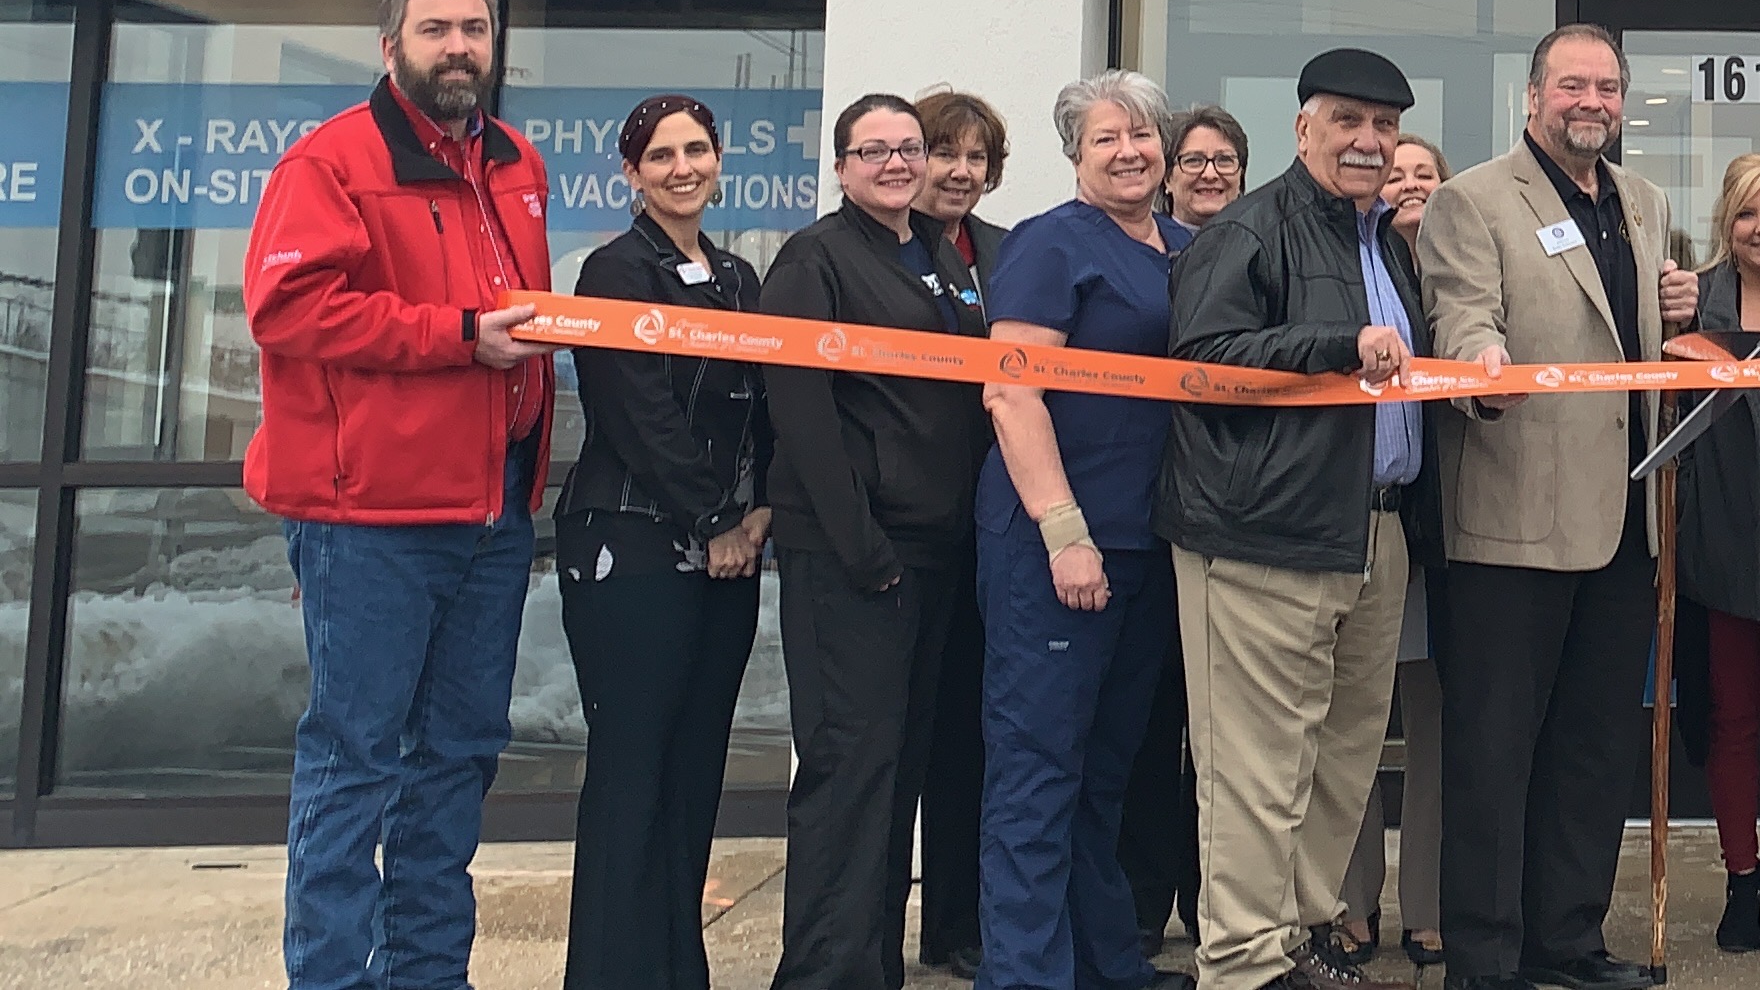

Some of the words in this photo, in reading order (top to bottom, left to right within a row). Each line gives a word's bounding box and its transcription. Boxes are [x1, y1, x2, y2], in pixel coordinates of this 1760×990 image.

[131, 118, 164, 155] X
[524, 118, 776, 156] PHYLS
[558, 172, 818, 210] VACTIONS
[555, 315, 601, 332] County
[689, 329, 736, 344] Charles
[738, 333, 784, 350] County
[1410, 375, 1457, 386] Charles
[1588, 372, 1633, 384] Charles
[1635, 371, 1679, 381] County
